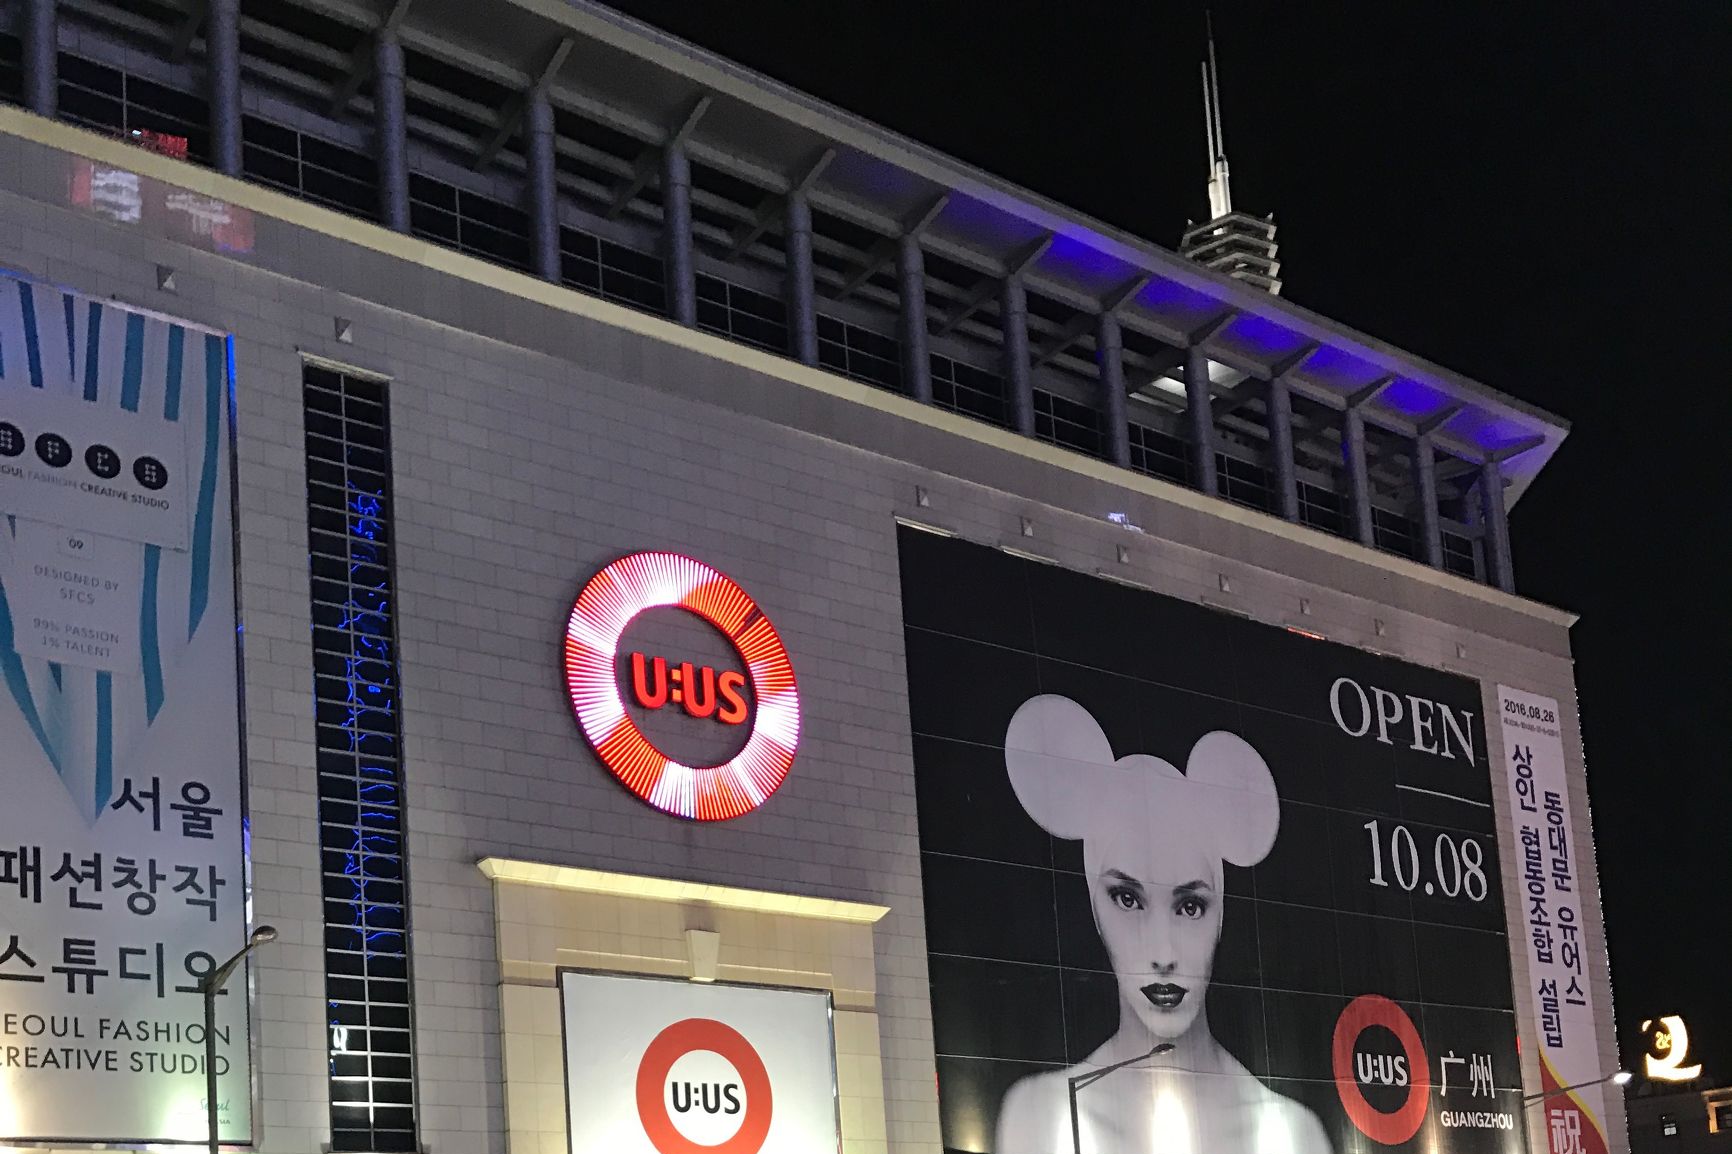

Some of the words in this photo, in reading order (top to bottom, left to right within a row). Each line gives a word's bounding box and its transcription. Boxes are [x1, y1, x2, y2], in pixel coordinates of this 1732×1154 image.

[80, 483, 128, 500] CREATIVE
[131, 493, 170, 510] STUDIO
[34, 564, 100, 588] DESIGNED
[104, 580, 119, 591] BY
[65, 624, 119, 644] PASSION
[65, 640, 111, 658] TALENT
[631, 650, 748, 725] U:US
[1329, 676, 1475, 768] OPEN
[111, 776, 223, 839] 서울
[1512, 744, 1538, 813] 상인
[1363, 819, 1488, 902] 10.08
[1543, 790, 1572, 893] 동대문
[0, 845, 226, 922] 패션창작
[1519, 824, 1554, 964] 협동조합
[0, 934, 229, 998] 스튜디오
[1557, 906, 1586, 1006] 유어스
[99, 1018, 230, 1046] FASHION
[1538, 978, 1564, 1049] 설립
[0, 1046, 118, 1071] REATIVE
[130, 1051, 230, 1076] STUDIO
[1356, 1052, 1408, 1087] U:US
[1440, 1050, 1496, 1099] 广州
[672, 1081, 741, 1115] U:US
[1440, 1110, 1514, 1130] GUANGZHOU
